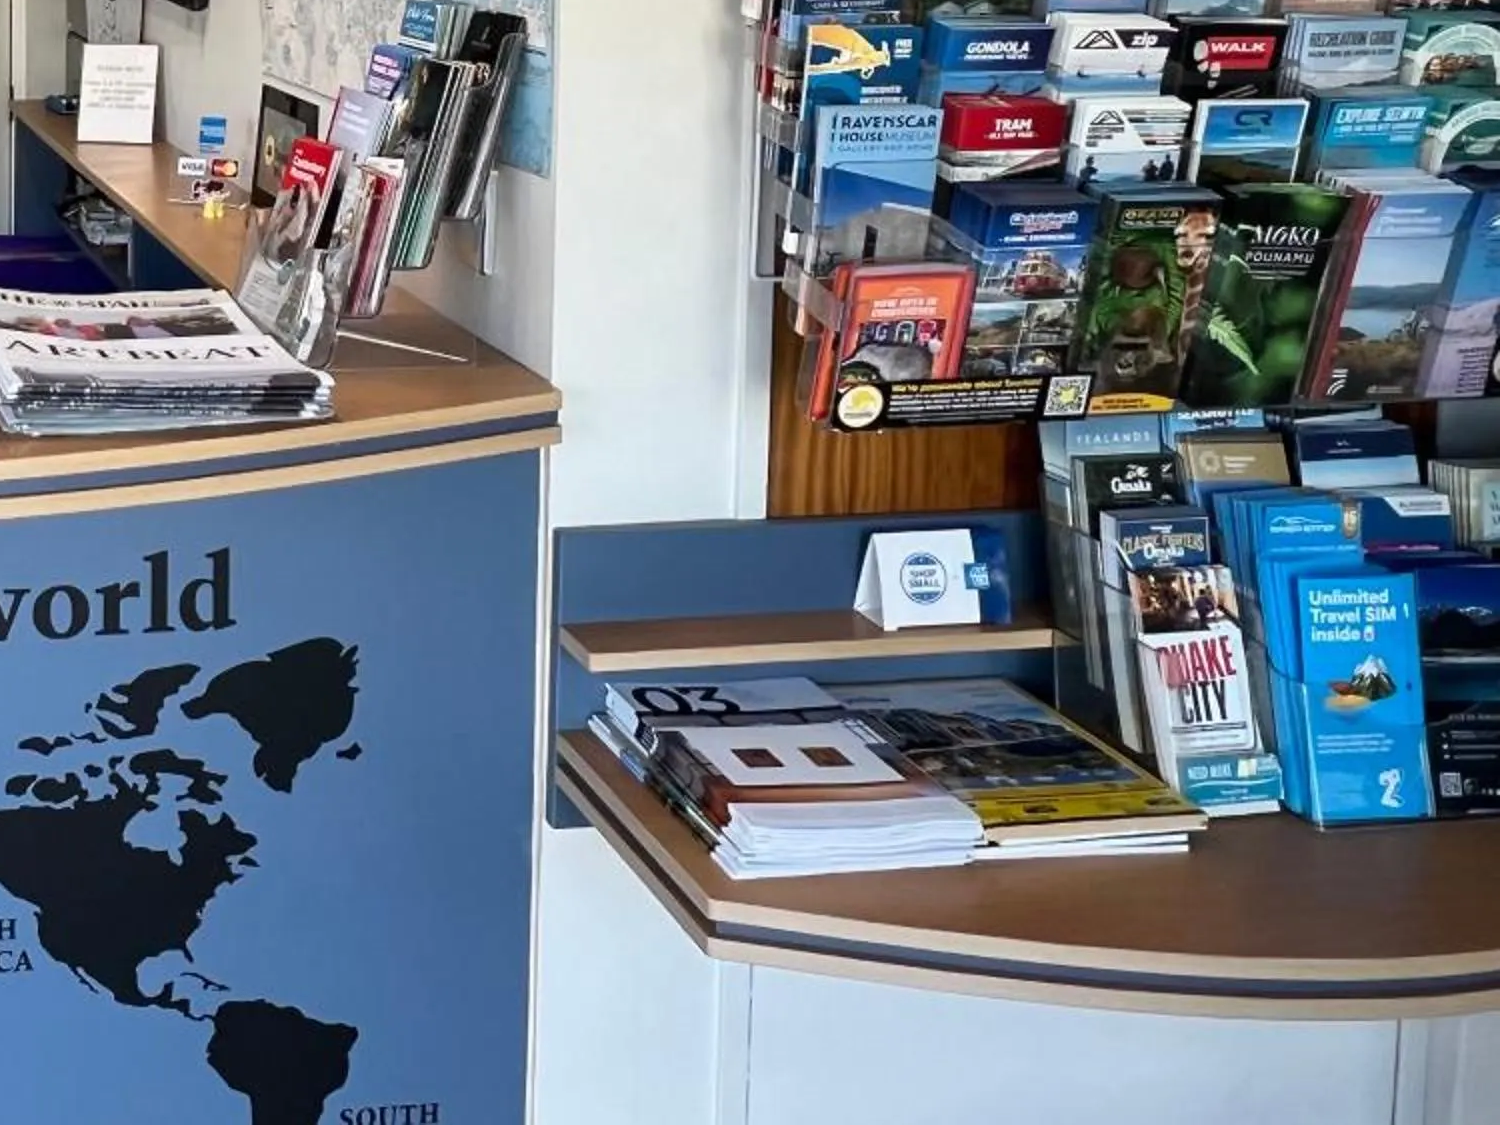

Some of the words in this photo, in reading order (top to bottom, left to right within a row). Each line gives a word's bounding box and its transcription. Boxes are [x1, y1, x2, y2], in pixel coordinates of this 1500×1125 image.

[966, 41, 1030, 54] GONDOLA
[1131, 32, 1158, 48] zip
[1211, 42, 1266, 53] WALK
[840, 114, 937, 129] RAVENSCAR
[995, 119, 1033, 131] TRAM
[838, 132, 884, 142] HOUSE
[1245, 251, 1316, 264] POUNAMU
[7, 340, 269, 360] ARTBEAT
[1076, 431, 1151, 444] YEALANDS
[1111, 478, 1153, 494] Omaka
[1122, 534, 1161, 555] CLASSIC
[1143, 544, 1185, 560] Omaka
[909, 569, 937, 578] SHOP
[907, 579, 941, 588] SMALL
[1309, 588, 1389, 605] Unlimited
[1311, 607, 1361, 623] Travel
[1365, 604, 1397, 621] SIM
[1311, 626, 1361, 643] inside
[1157, 634, 1238, 689] QUAKE
[631, 686, 741, 716] 03
[1180, 679, 1230, 725] CITY
[340, 1102, 439, 1125] SOUTH
